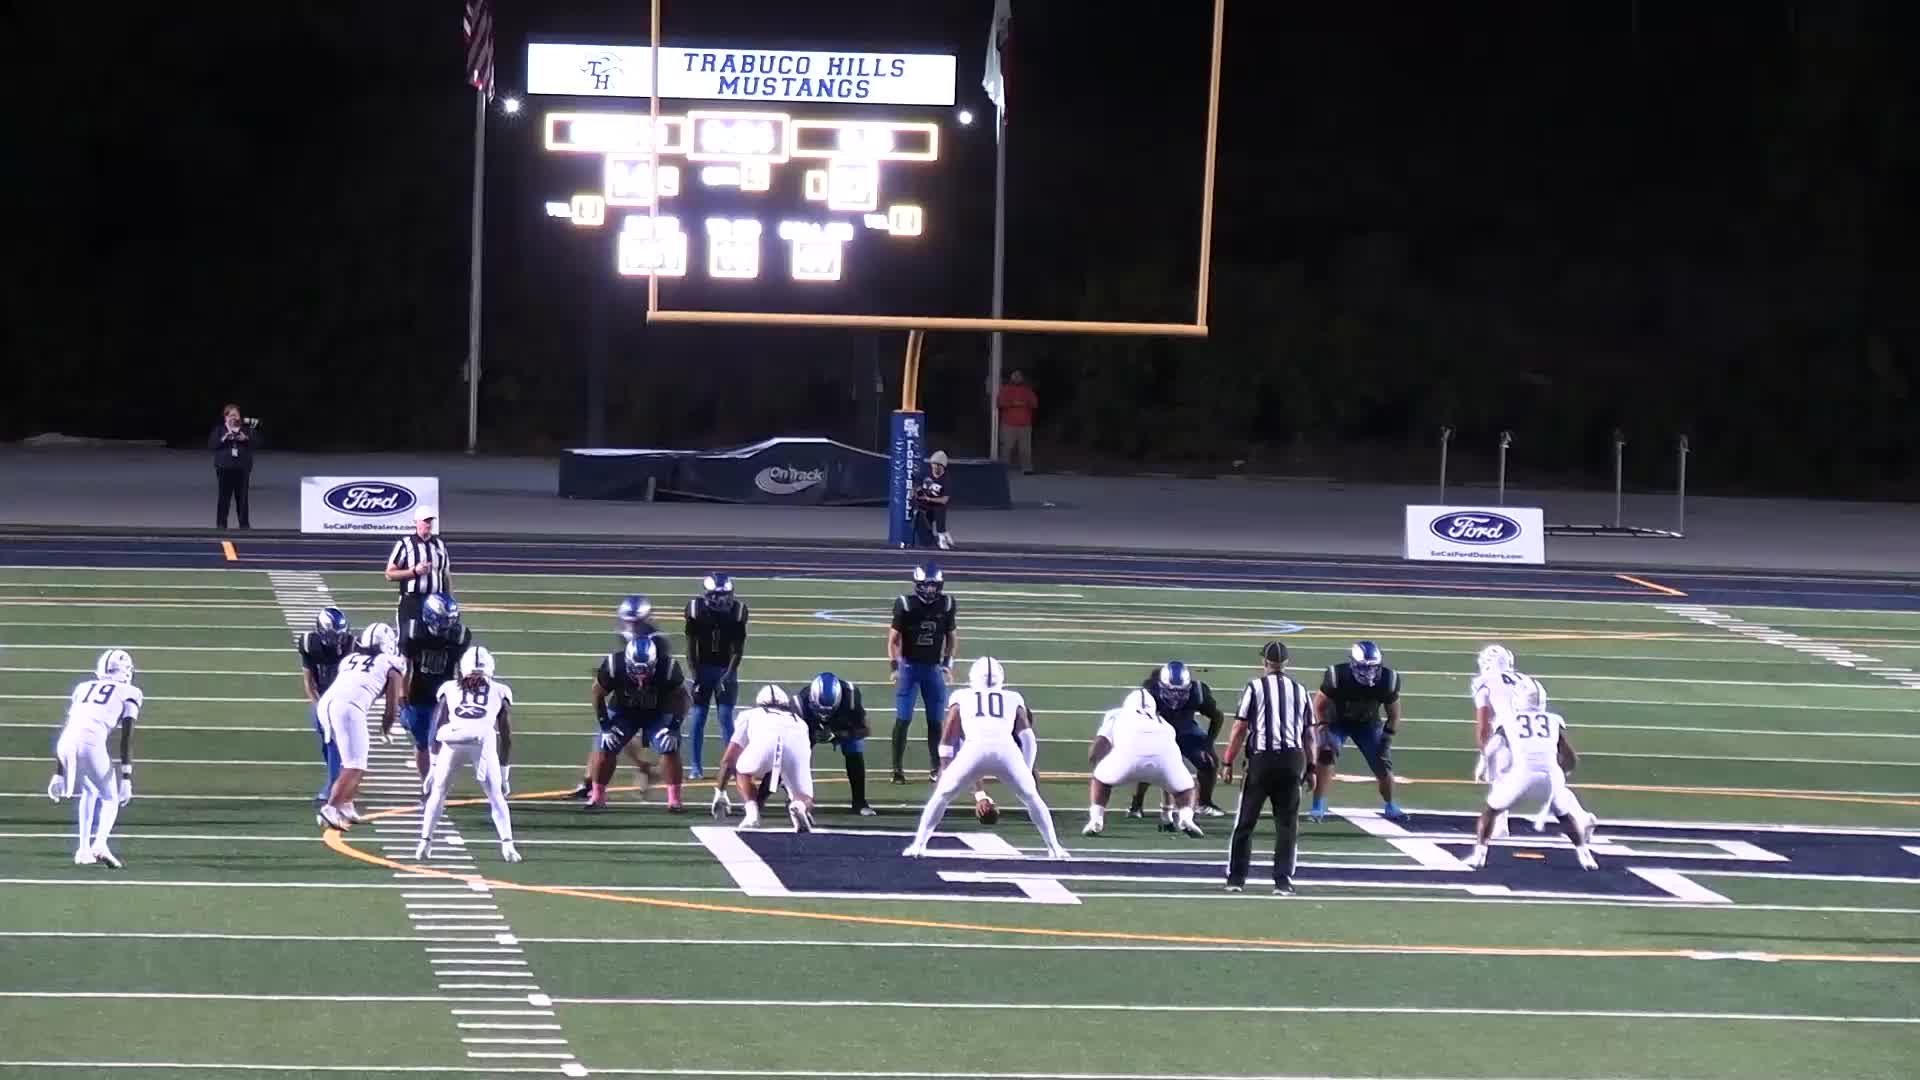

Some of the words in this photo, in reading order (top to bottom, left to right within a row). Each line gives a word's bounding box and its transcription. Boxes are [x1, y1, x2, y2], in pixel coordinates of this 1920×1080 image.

[684, 52, 811, 75] TRABUCO
[827, 57, 906, 78] HILLS
[717, 76, 871, 98] MUSTANGS
[341, 487, 398, 510] Ford
[1448, 516, 1504, 539] Ford
[917, 622, 937, 646] 2
[348, 655, 376, 673] 54
[81, 683, 115, 705] 19
[975, 691, 1005, 719] 10
[1516, 714, 1550, 739] 33
